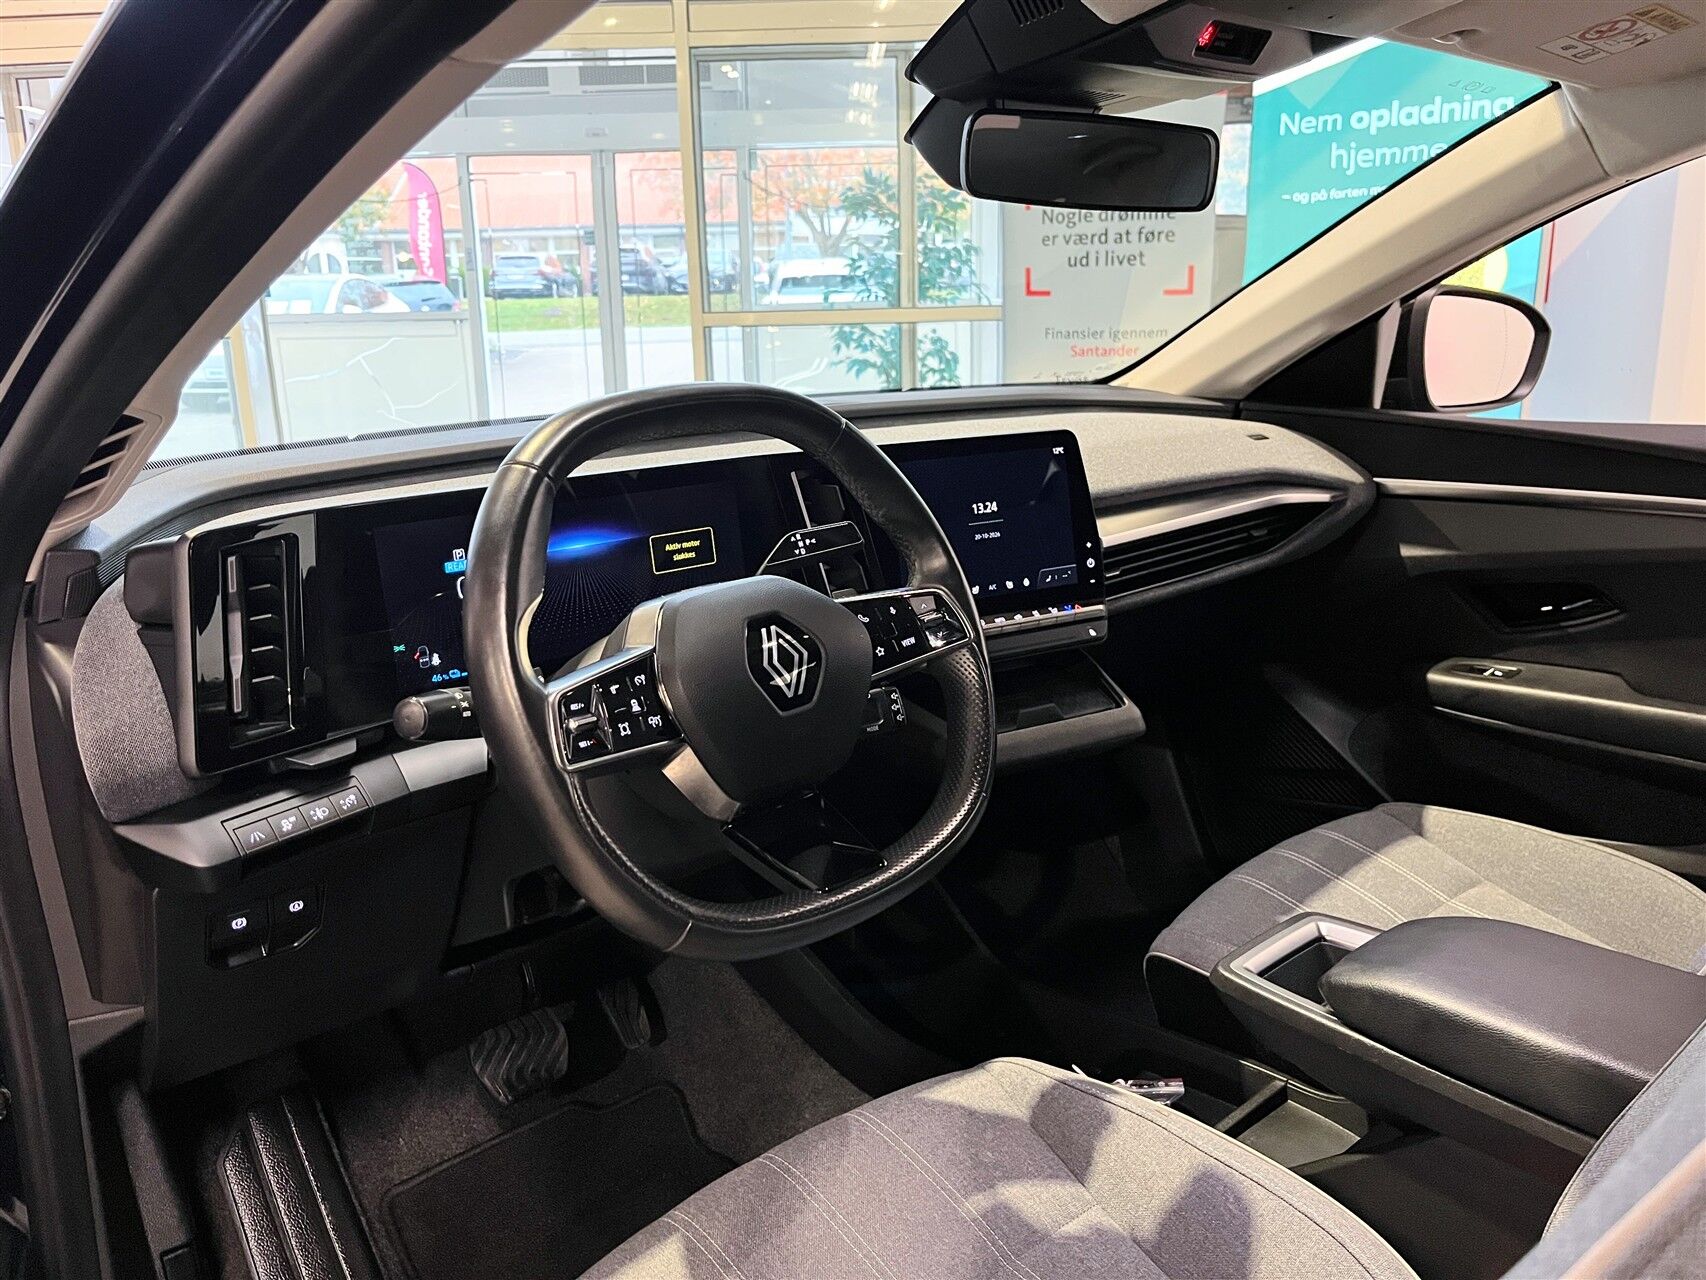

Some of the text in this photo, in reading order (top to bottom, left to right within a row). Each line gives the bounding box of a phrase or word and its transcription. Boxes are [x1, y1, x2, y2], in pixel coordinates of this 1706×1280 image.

[1279, 94, 1515, 136] Nem opladning
[1292, 192, 1310, 205] og
[1329, 187, 1369, 200] farten
[1042, 209, 1093, 229] Nogle
[1042, 226, 1176, 247] er værd at føre
[1067, 250, 1146, 268] ud i livet
[1044, 327, 1168, 341] Finansier igennem
[1071, 344, 1139, 358] Santander
[971, 500, 998, 515] 13.24
[446, 561, 467, 572] REA
[901, 636, 916, 648] VIEW
